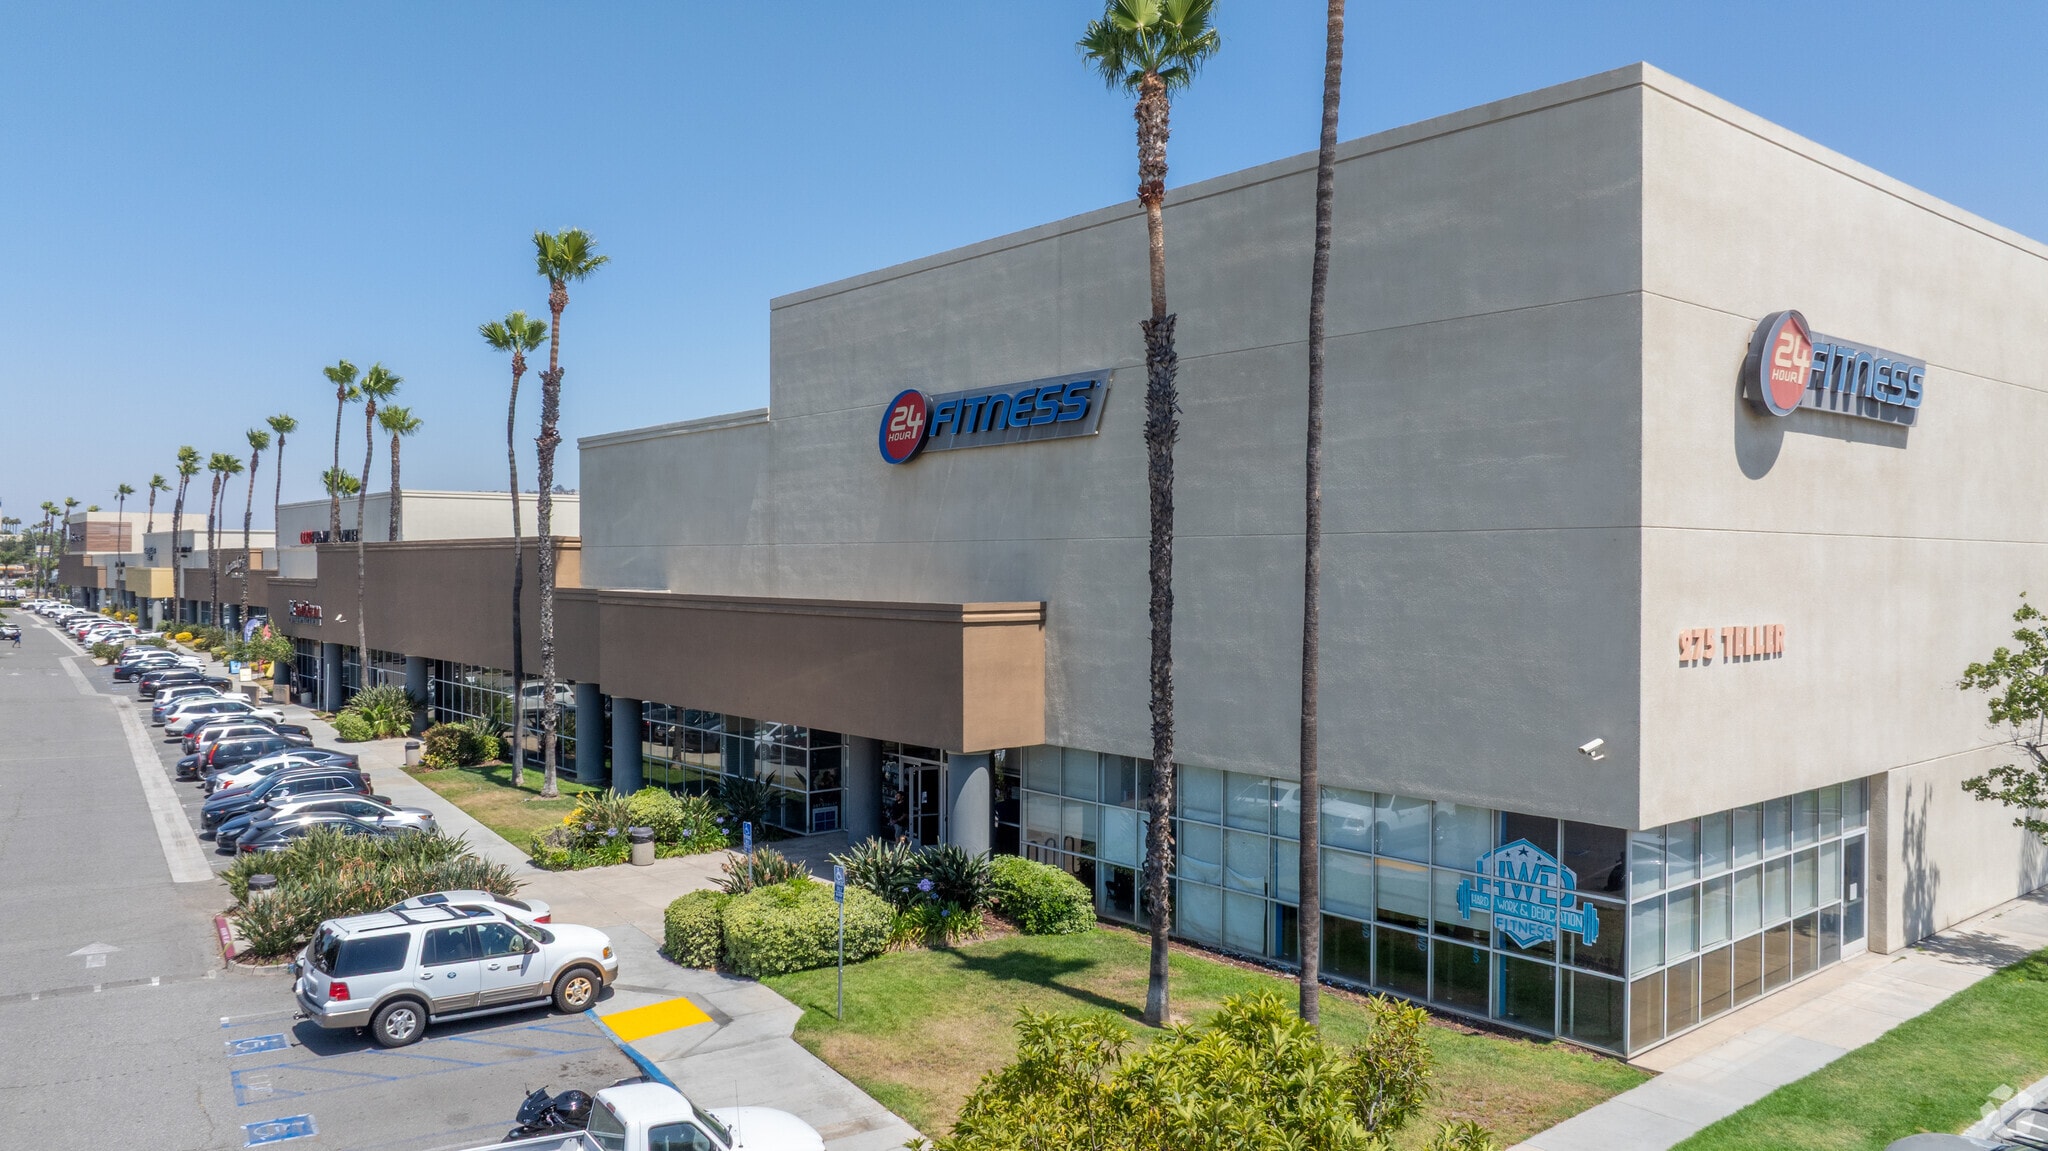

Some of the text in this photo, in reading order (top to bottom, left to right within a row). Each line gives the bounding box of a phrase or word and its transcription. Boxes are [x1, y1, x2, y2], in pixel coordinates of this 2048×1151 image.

[1775, 332, 1810, 384] 24
[1771, 368, 1797, 383] HOUR
[1807, 342, 1925, 409] FITNESS
[890, 405, 923, 439] 24
[929, 380, 1095, 437] FITNESS
[888, 431, 911, 442] HOUR
[1678, 628, 1715, 661] 975
[1477, 860, 1574, 908] HWD
[1471, 893, 1490, 907] HARD
[1496, 898, 1519, 914] WORK
[1520, 903, 1529, 918] &
[1496, 917, 1554, 939] FITNESS
